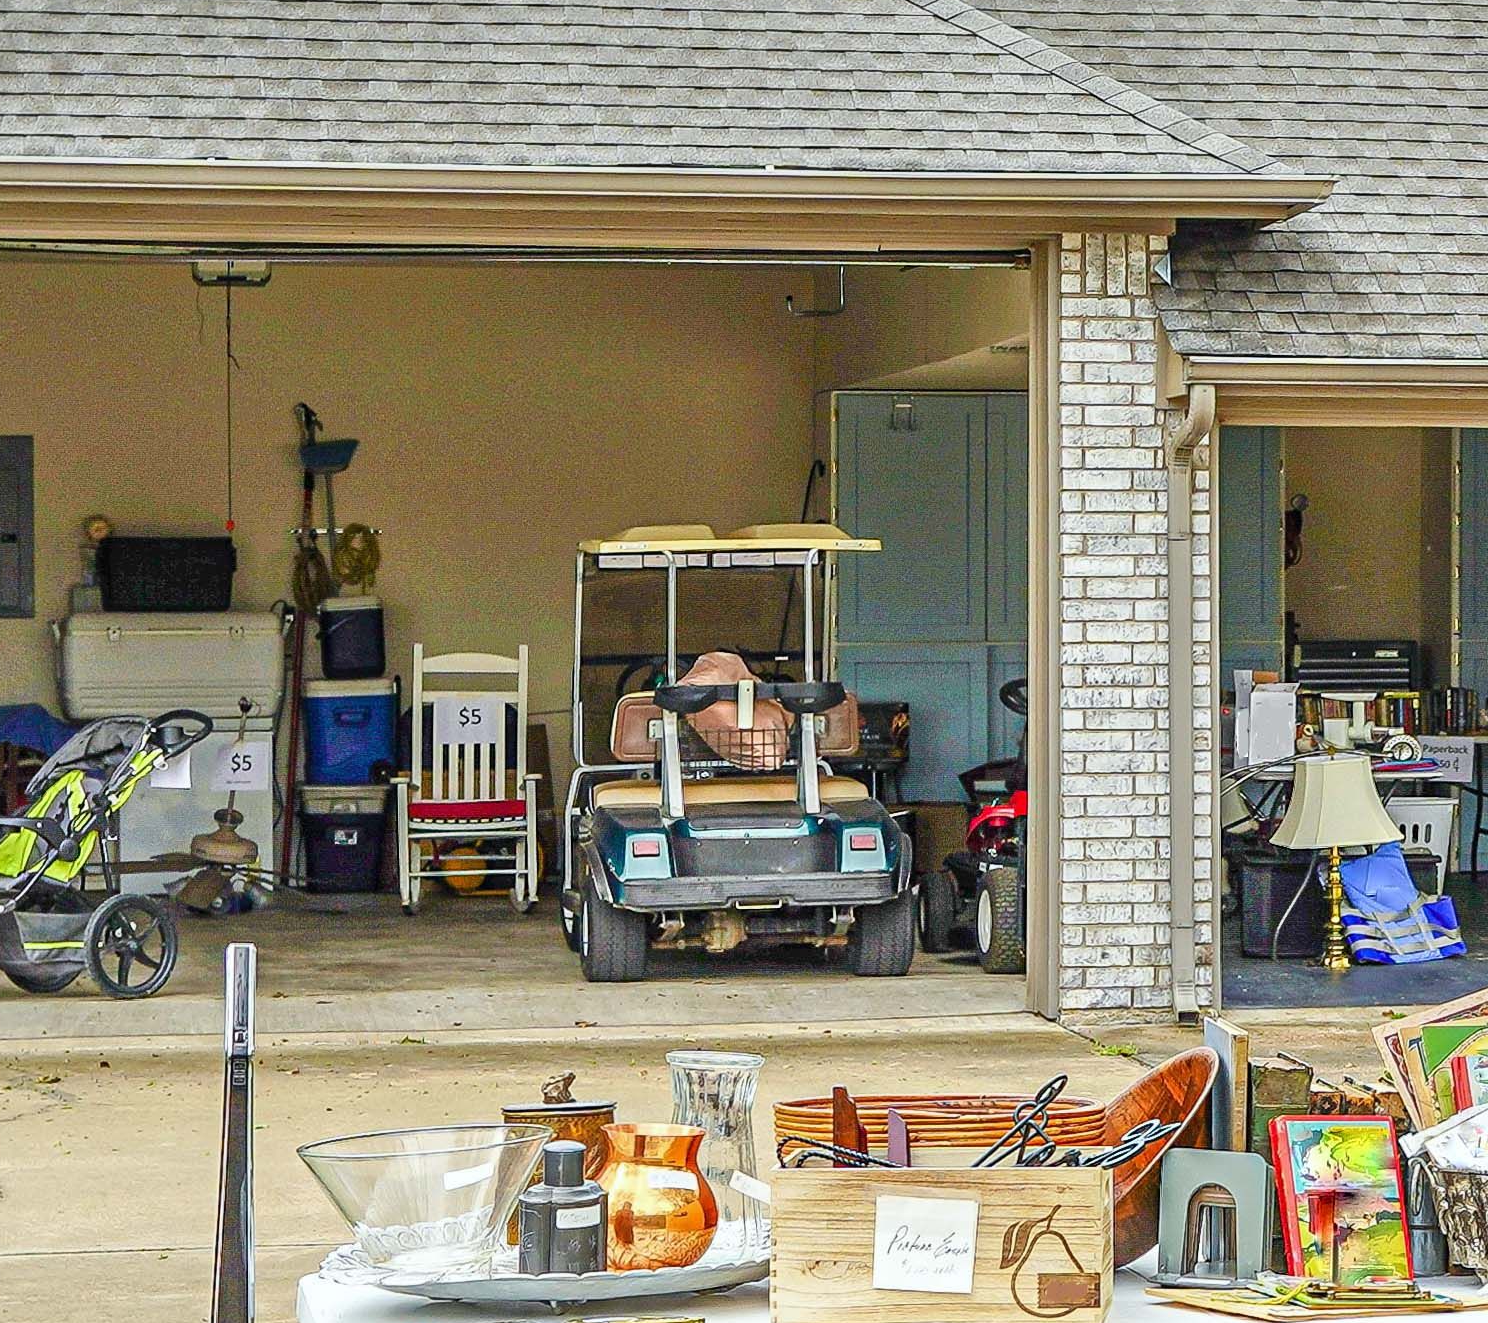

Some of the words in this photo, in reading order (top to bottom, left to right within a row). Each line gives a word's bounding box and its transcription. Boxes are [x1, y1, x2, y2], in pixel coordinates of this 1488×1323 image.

[459, 706, 482, 727] $5
[1423, 743, 1469, 754] Paperback
[231, 752, 252, 774] $5
